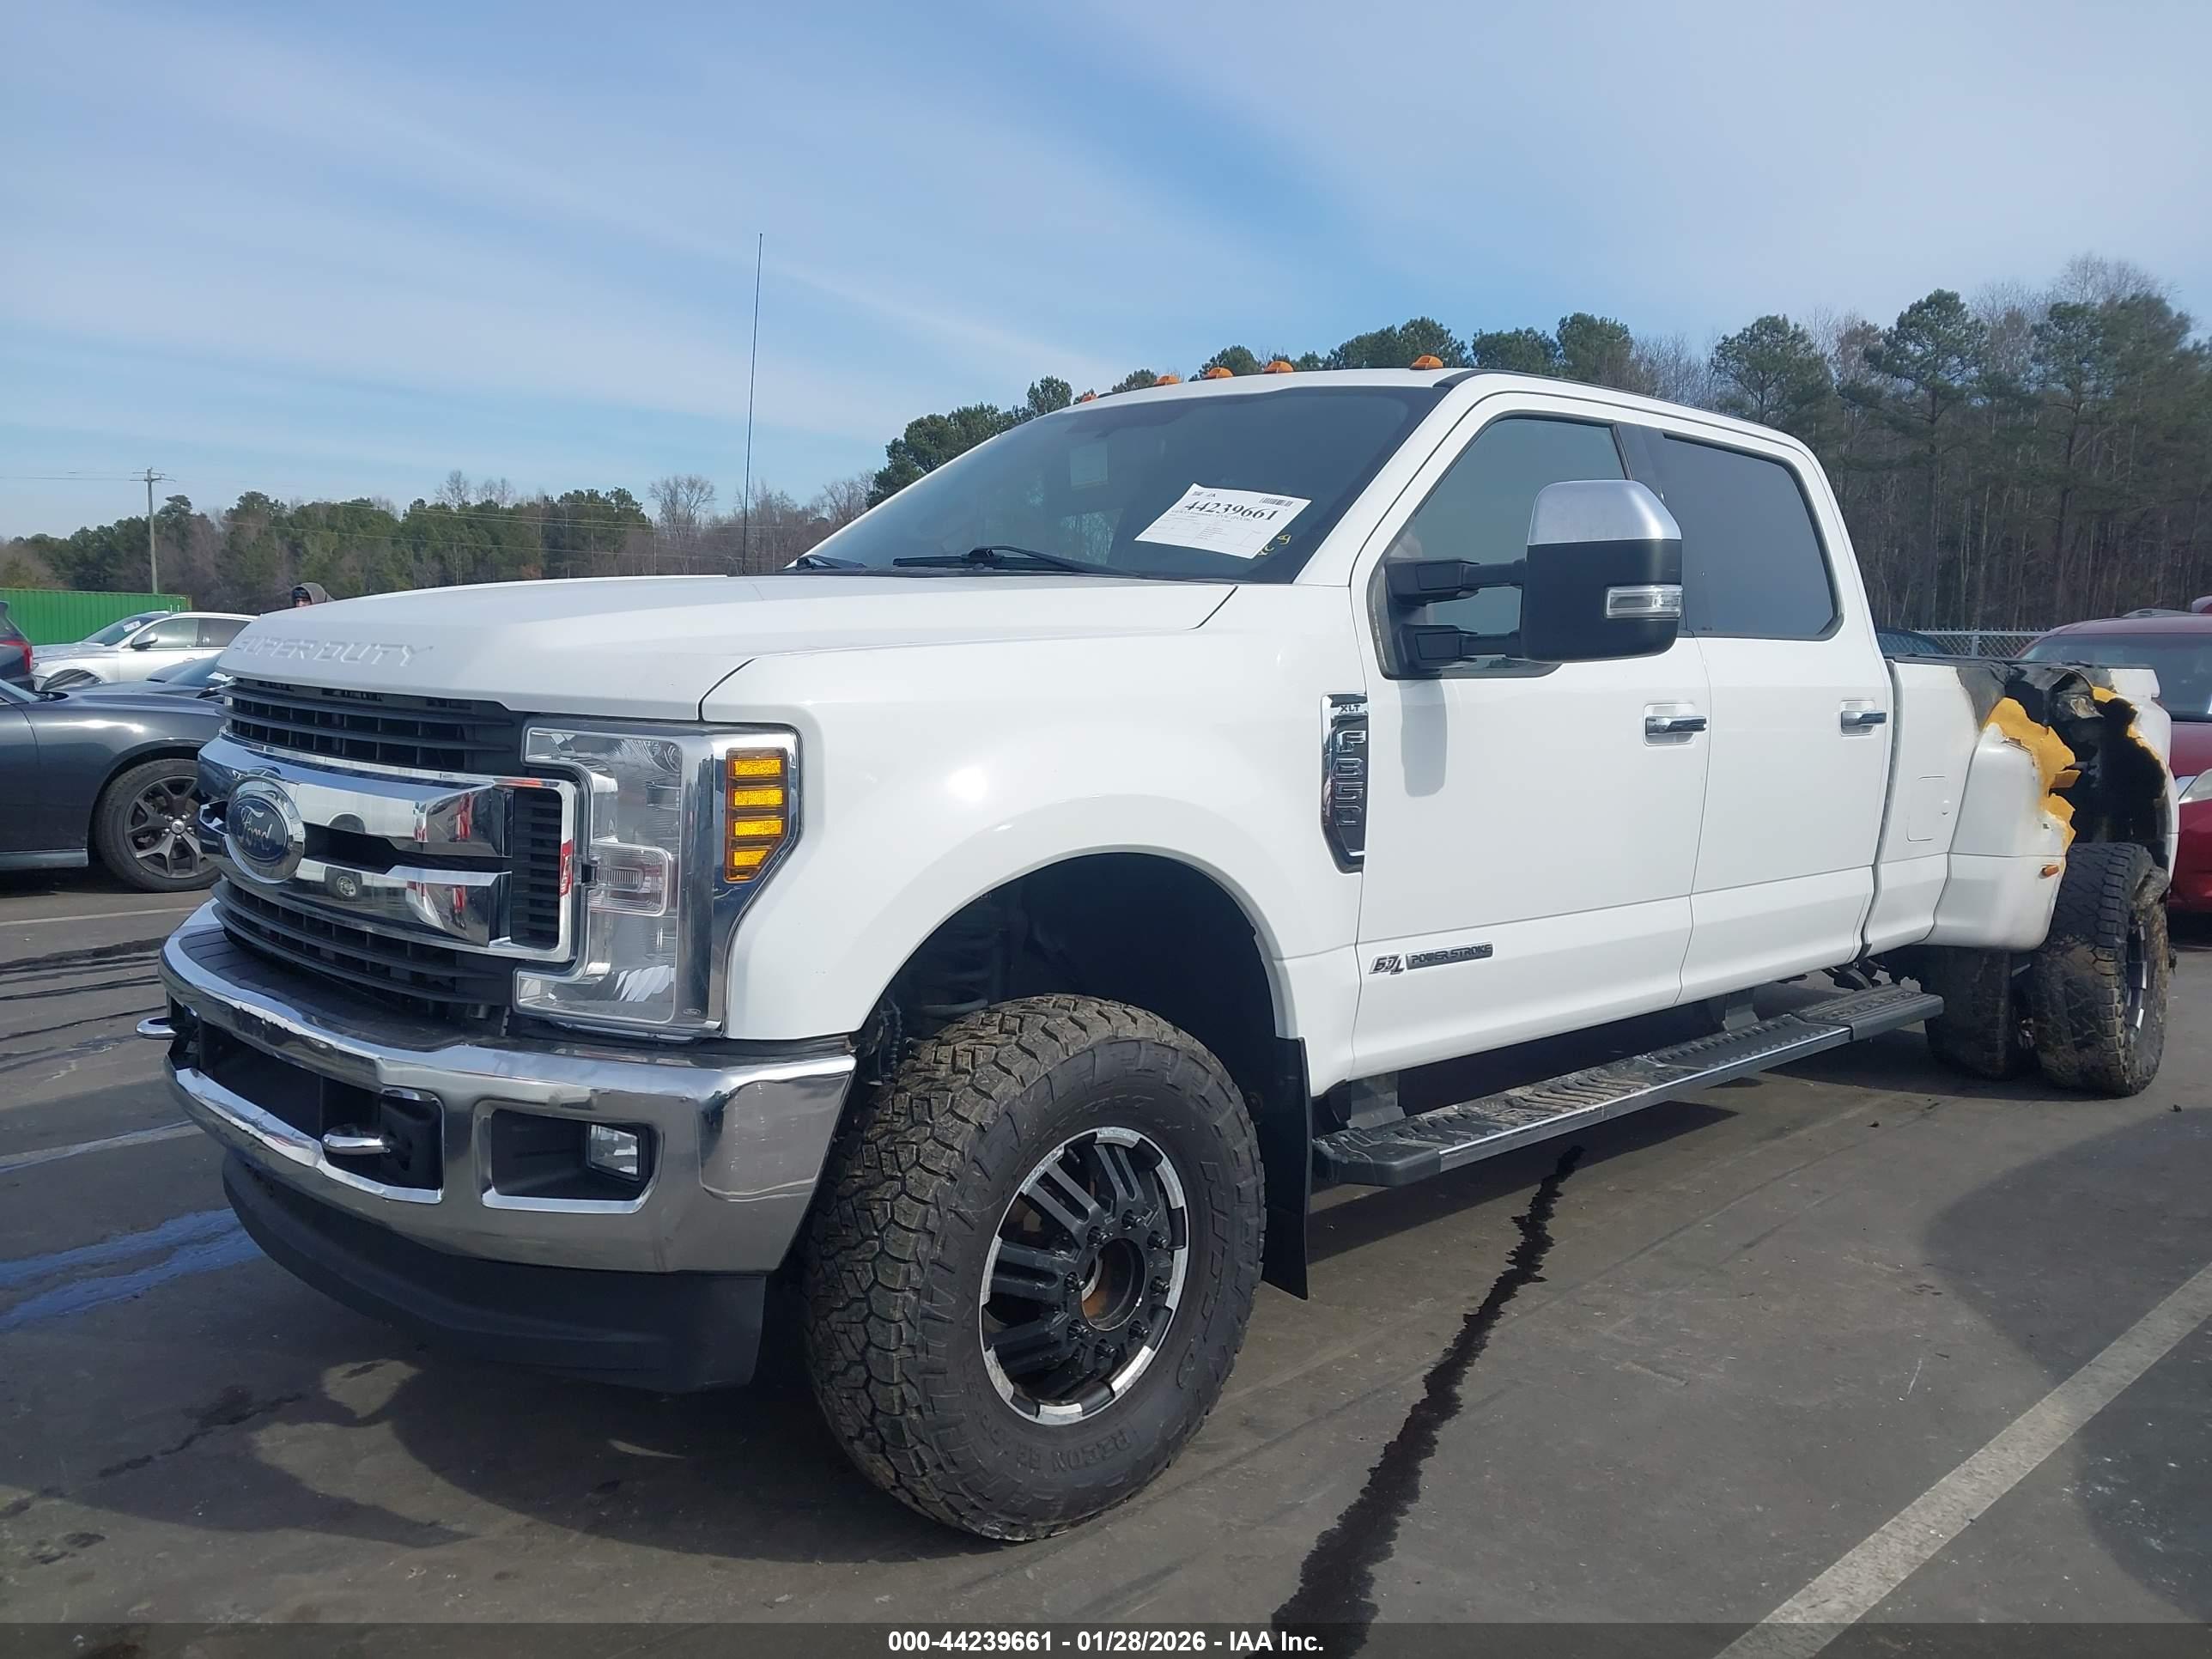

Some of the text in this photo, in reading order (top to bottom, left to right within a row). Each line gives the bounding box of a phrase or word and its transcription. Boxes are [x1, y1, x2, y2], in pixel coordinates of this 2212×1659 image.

[1185, 501, 1279, 520] 44239661
[313, 641, 434, 667] DUTY
[1340, 704, 1361, 713] XLT
[238, 805, 273, 840] Ford
[1412, 951, 1449, 964] POWER
[1450, 944, 1492, 958] STROKE
